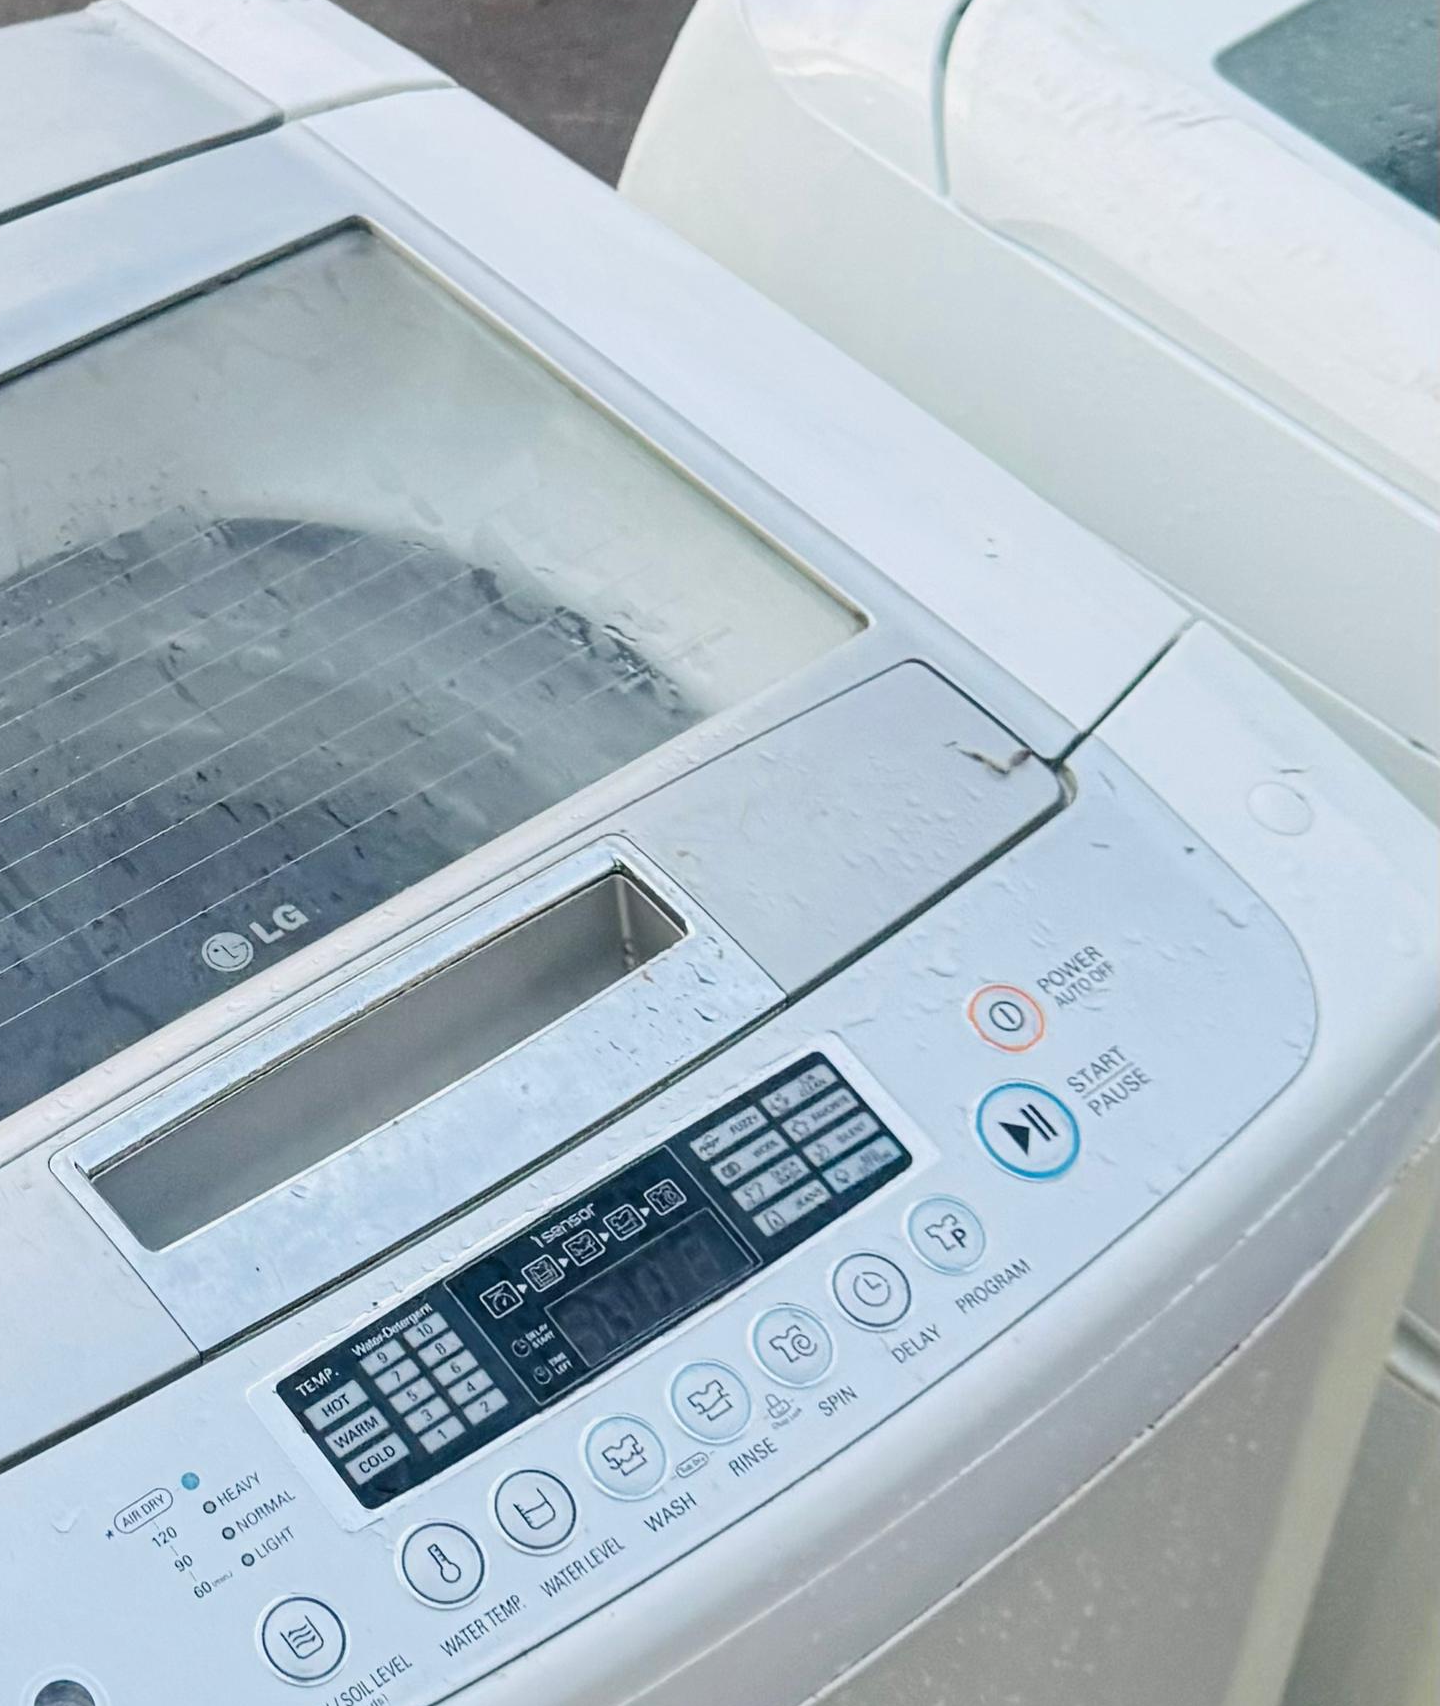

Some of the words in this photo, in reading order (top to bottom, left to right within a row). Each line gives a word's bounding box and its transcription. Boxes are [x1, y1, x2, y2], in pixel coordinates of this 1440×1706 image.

[249, 904, 309, 944] LG
[1036, 945, 1104, 994] POWER
[1053, 979, 1091, 1009] AUTO
[1090, 961, 1115, 985] OFF
[1066, 1045, 1128, 1094] START
[1087, 1066, 1153, 1117] PAUSE
[729, 1114, 759, 1135] FUZZY
[951, 1228, 968, 1249] P
[955, 1258, 1032, 1315] PROGRAM
[376, 1351, 388, 1365] 9
[417, 1323, 433, 1338] 10
[391, 1370, 401, 1384] 7
[435, 1342, 447, 1355] 8
[890, 1324, 943, 1364] DELAY
[295, 1366, 340, 1397] TEMP.
[409, 1389, 419, 1403] 5
[450, 1362, 462, 1375] 6
[423, 1408, 434, 1422] 3
[465, 1381, 476, 1395] 4
[818, 1385, 859, 1418] SPIN
[321, 1395, 351, 1418] HOT
[437, 1428, 448, 1441] 1
[480, 1400, 491, 1414] 2
[334, 1416, 379, 1449] WARM
[359, 1444, 396, 1474] COLD
[728, 1437, 779, 1478] RINSE
[216, 1472, 261, 1508] HEAVY
[122, 1509, 144, 1529] AIR
[140, 1494, 165, 1516] DRY
[236, 1490, 296, 1534] NORMAL
[643, 1492, 698, 1534] WASH
[151, 1526, 178, 1548] 120
[254, 1526, 296, 1560] LIGHT
[174, 1554, 194, 1573] 90
[539, 1559, 587, 1599] WATER
[584, 1537, 626, 1572] LEVEL
[193, 1581, 213, 1599] 60
[439, 1620, 488, 1659] WATER
[485, 1594, 527, 1627] TEMP.
[368, 1653, 413, 1689] LEVEL
